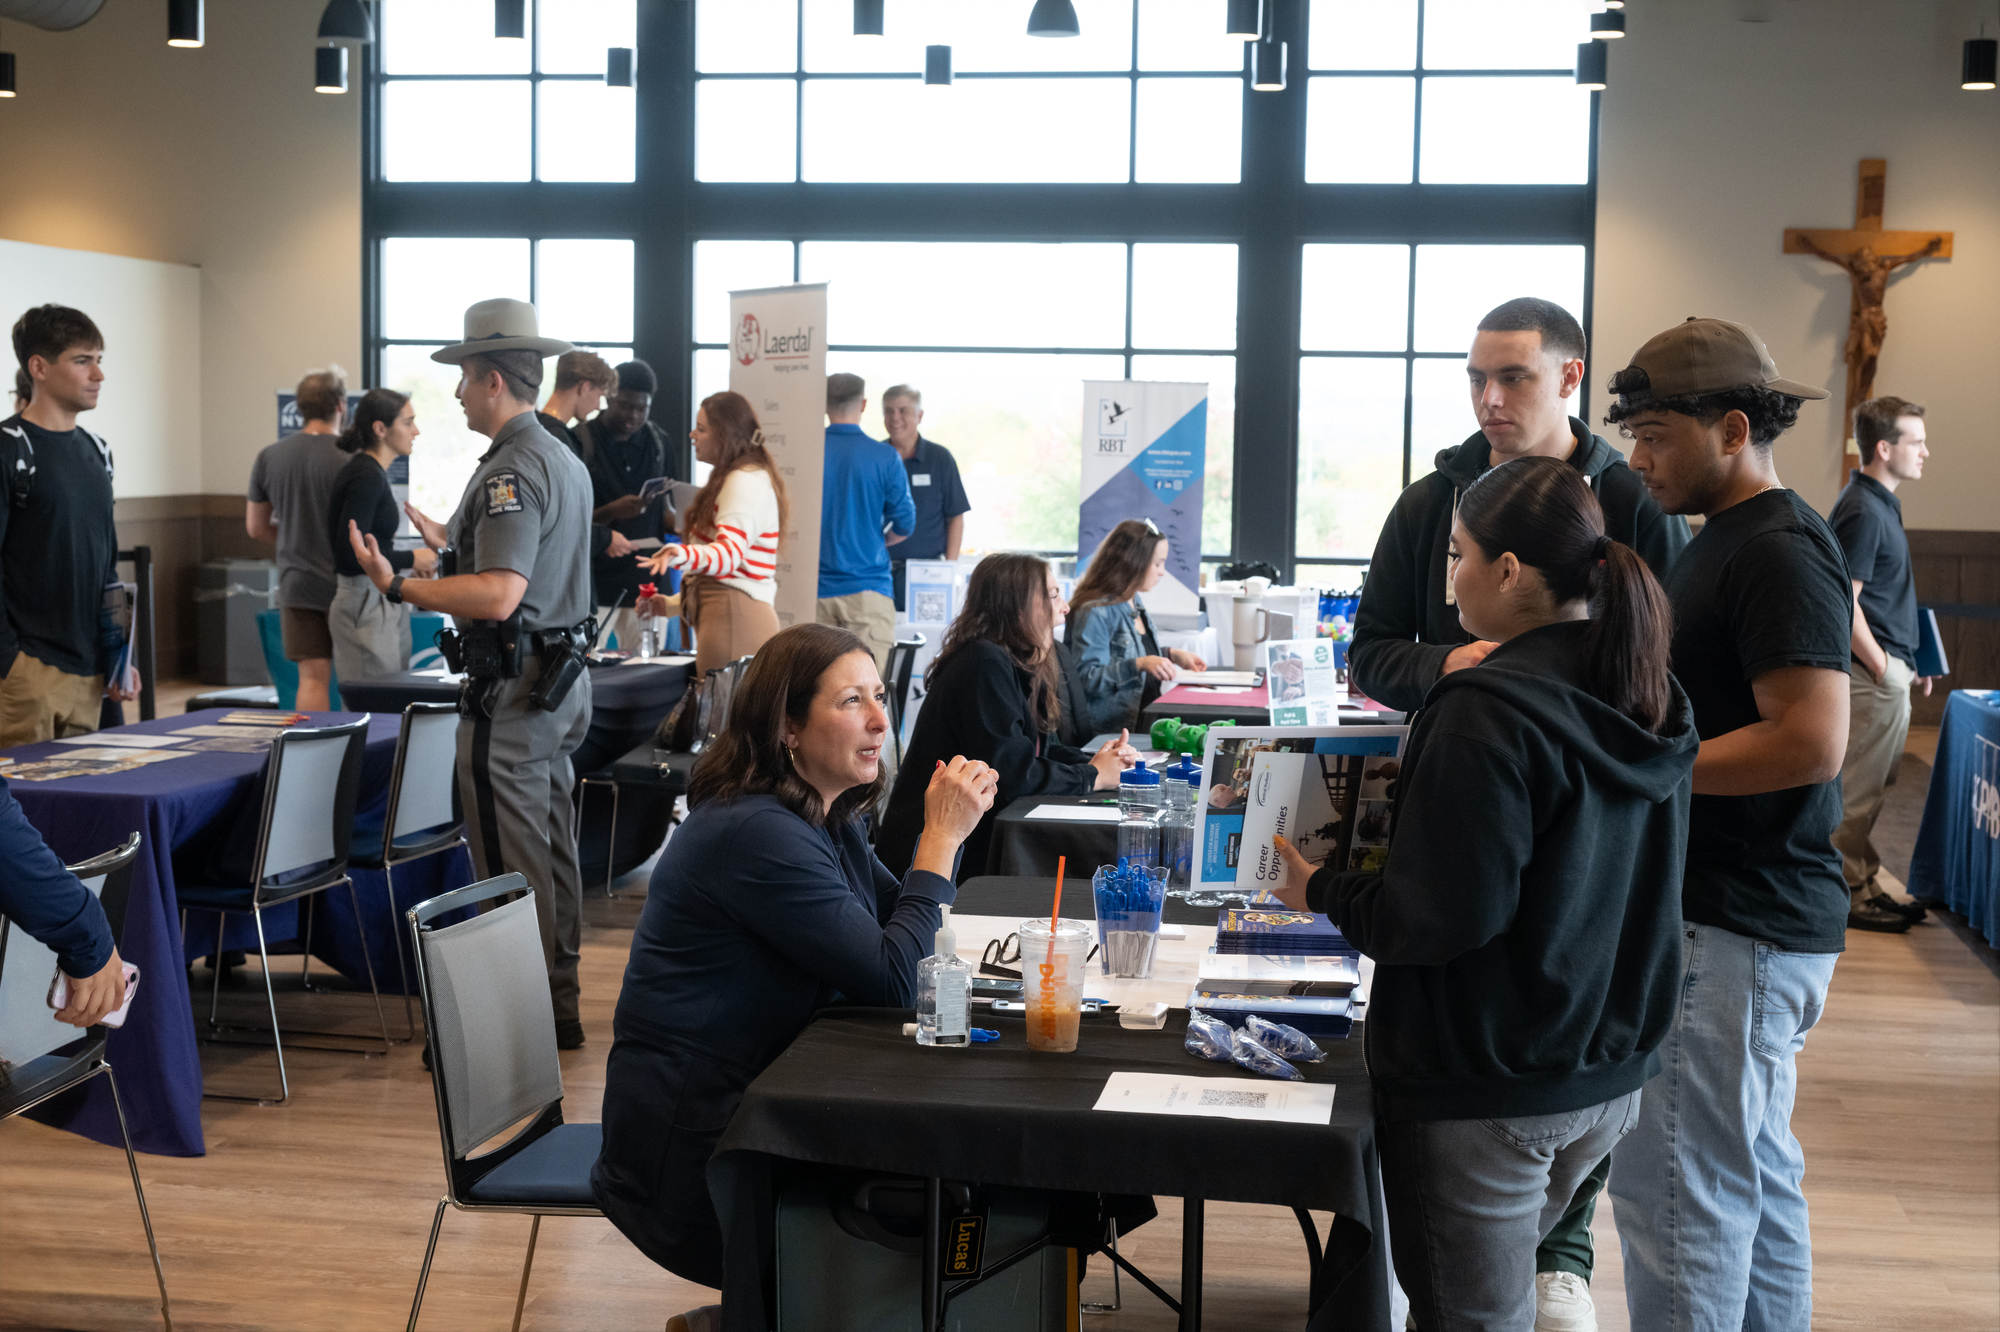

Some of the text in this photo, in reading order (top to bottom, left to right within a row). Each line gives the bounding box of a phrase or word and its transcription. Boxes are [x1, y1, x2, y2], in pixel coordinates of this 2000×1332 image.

[764, 326, 812, 354] Laerdal
[1099, 438, 1127, 452] RBT
[1268, 806, 1288, 881] Opponities
[1255, 844, 1269, 880] Career
[954, 1221, 976, 1271] Lucas
